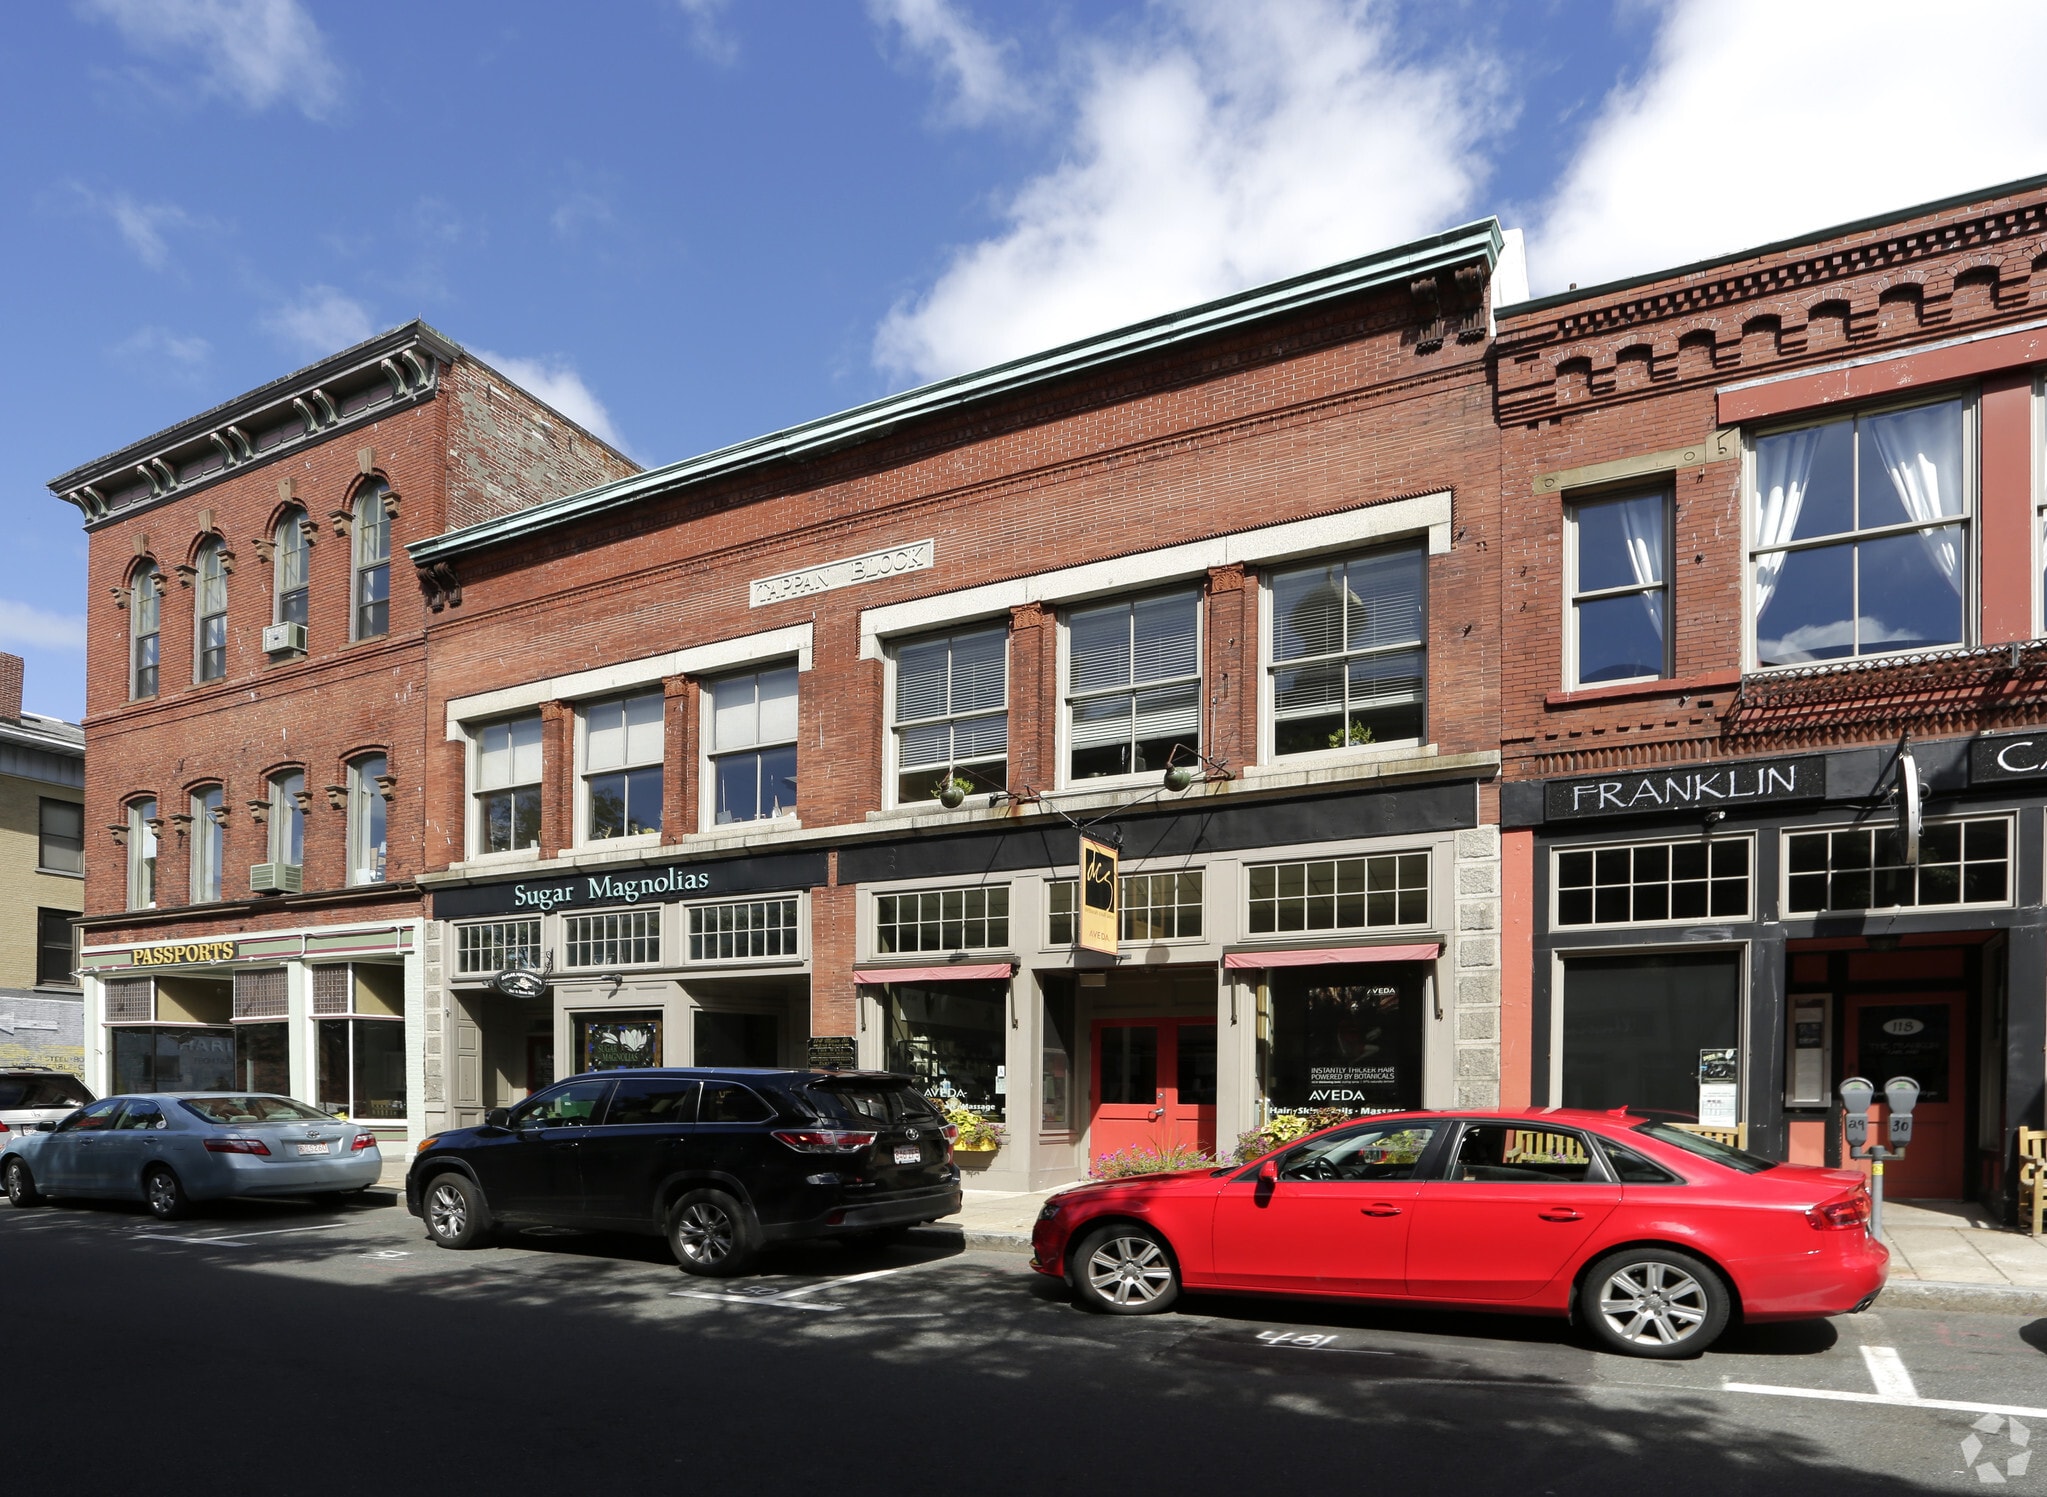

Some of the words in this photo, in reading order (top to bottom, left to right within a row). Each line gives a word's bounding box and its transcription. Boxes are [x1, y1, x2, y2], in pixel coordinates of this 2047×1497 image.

[756, 568, 830, 603] TAPPAN
[850, 546, 924, 582] BLOCK
[1997, 741, 2047, 772] C
[1572, 764, 1797, 811] FRANKLIN
[514, 884, 574, 911] Sugar
[587, 866, 710, 903] Magnolias
[1089, 930, 1110, 942] AVEDA
[132, 941, 234, 966] PASSPORTS
[1892, 1021, 1914, 1032] 118
[924, 1088, 965, 1098] AVEDA
[1308, 1089, 1365, 1101] AVEDA
[1848, 1119, 1865, 1131] 29
[1892, 1120, 1909, 1132] 30
